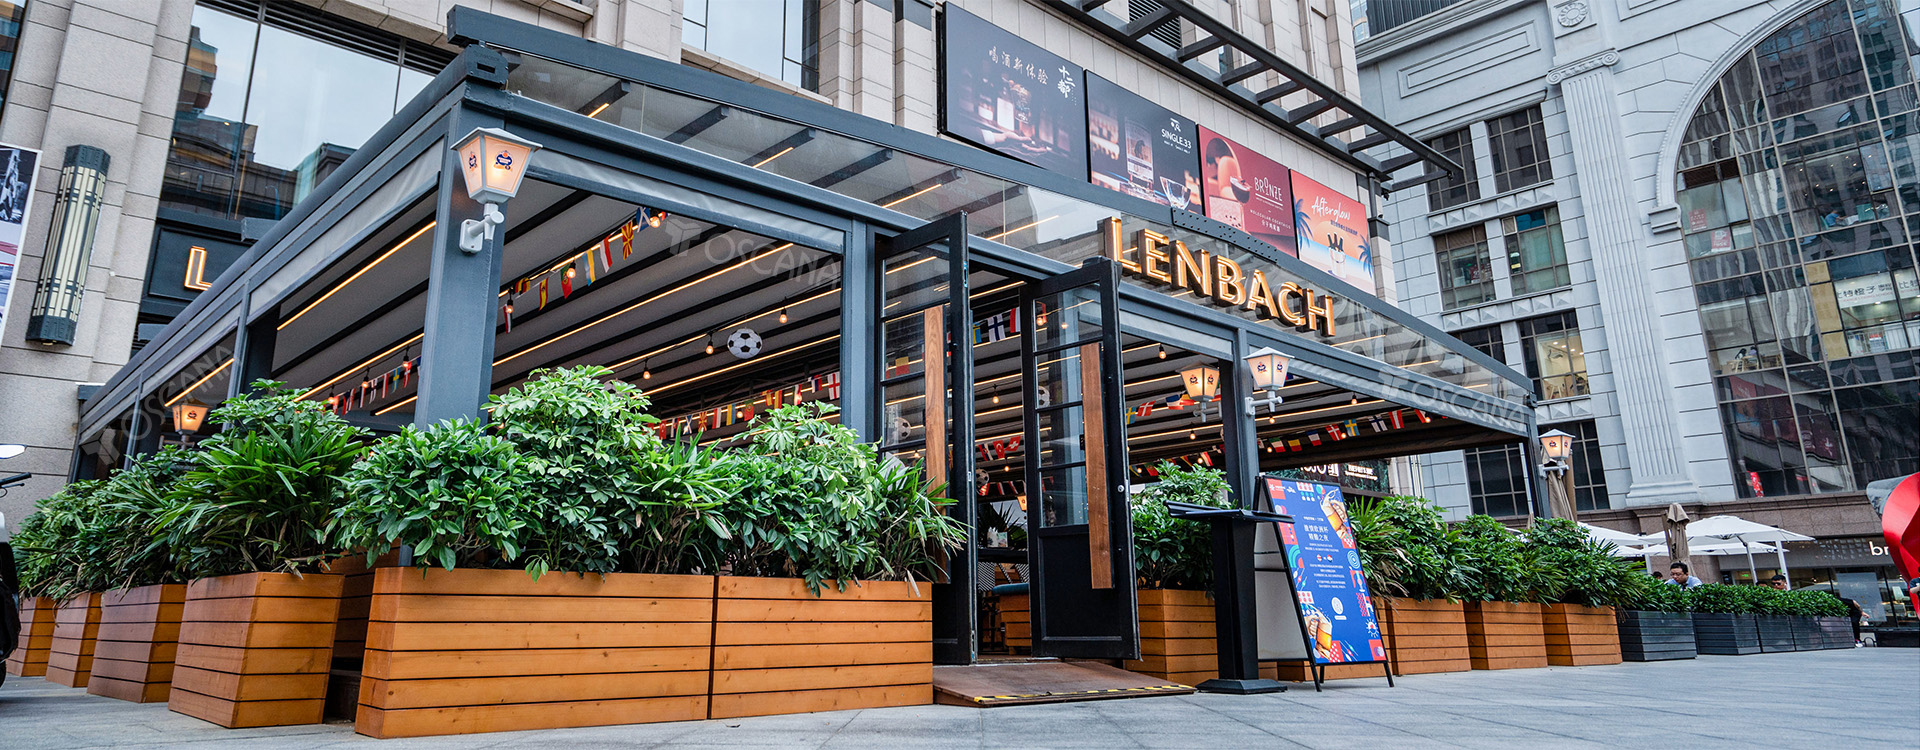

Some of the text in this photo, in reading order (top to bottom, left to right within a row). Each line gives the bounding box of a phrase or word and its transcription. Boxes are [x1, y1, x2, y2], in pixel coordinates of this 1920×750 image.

[988, 45, 1049, 85] 喝酒新体验
[1161, 128, 1192, 150] SINGLE.33
[1254, 176, 1283, 202] BRONZE
[1311, 195, 1351, 222] Afterglow
[184, 245, 213, 291] L
[1105, 216, 1336, 337] LENBACH
